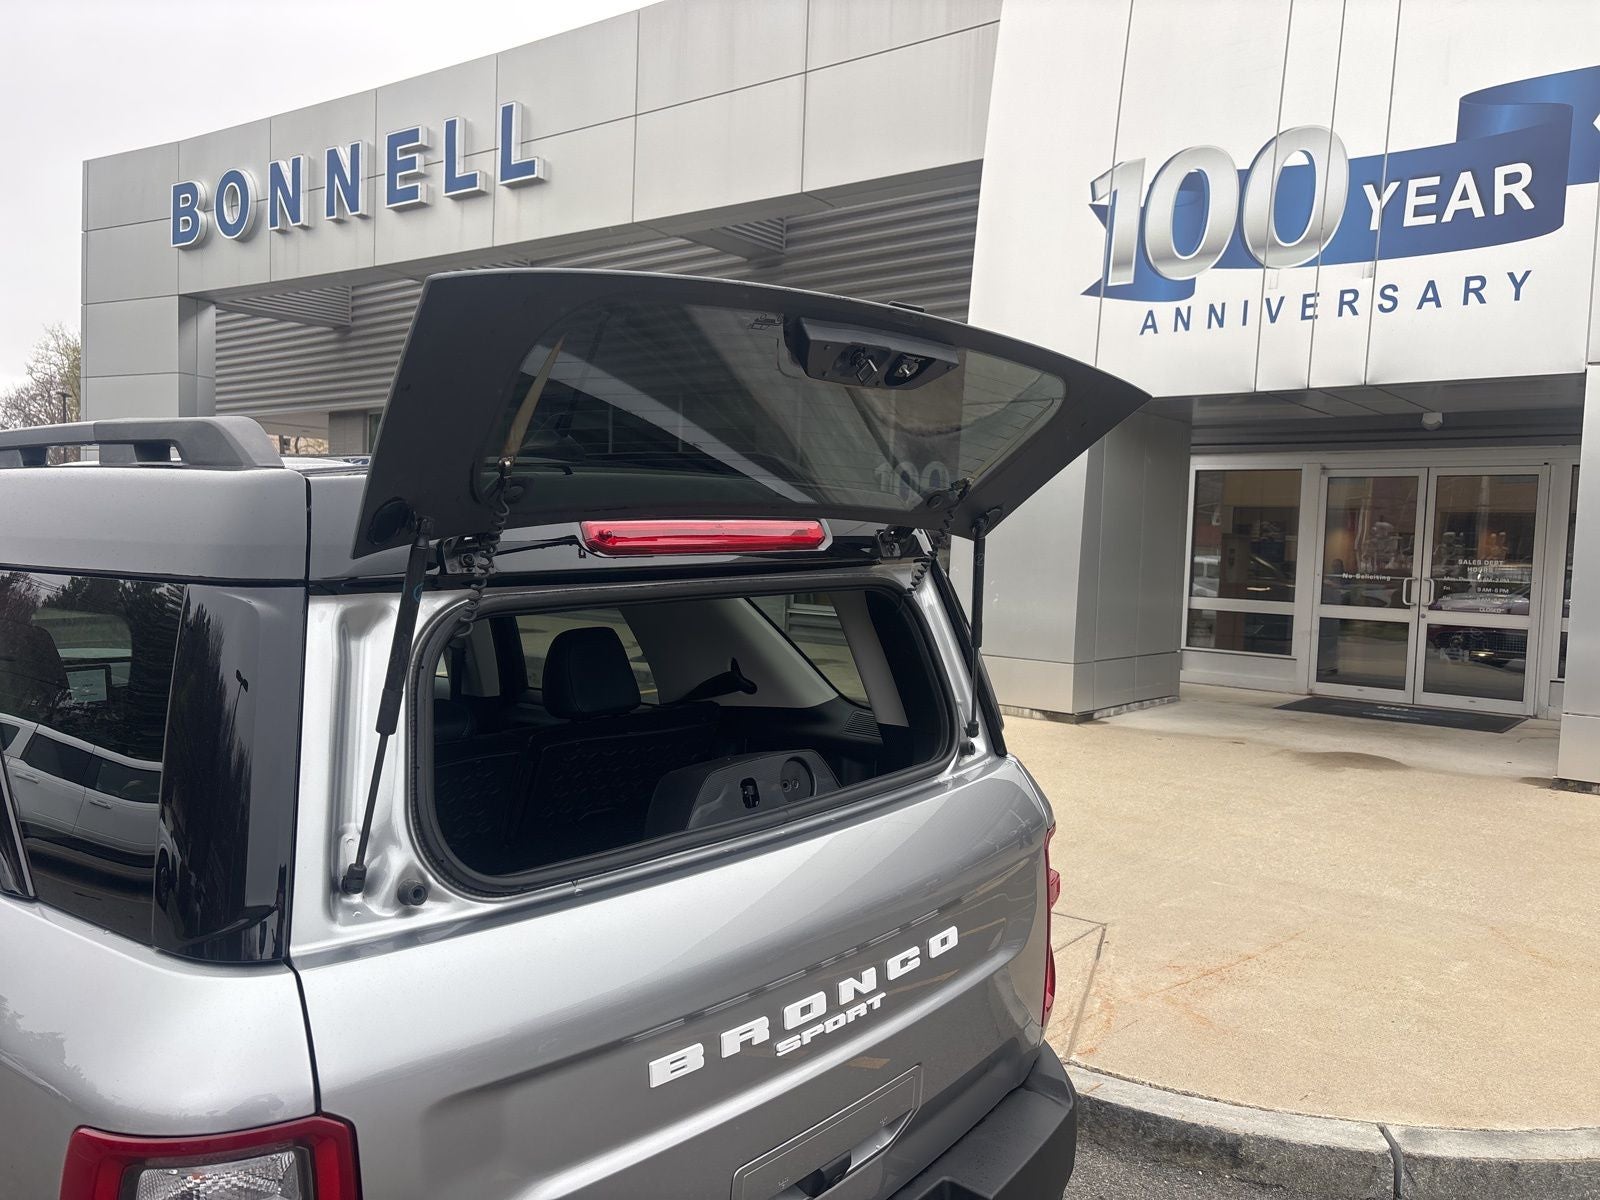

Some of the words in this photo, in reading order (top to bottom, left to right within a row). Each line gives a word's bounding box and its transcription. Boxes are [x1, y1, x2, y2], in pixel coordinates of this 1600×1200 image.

[170, 101, 547, 249] BONNELL
[1088, 124, 1349, 286] 100
[1362, 161, 1536, 231] YEAR
[1138, 269, 1533, 336] ANNIVERSARY
[648, 925, 959, 1088] BRONCO
[775, 992, 887, 1057] SPORT
